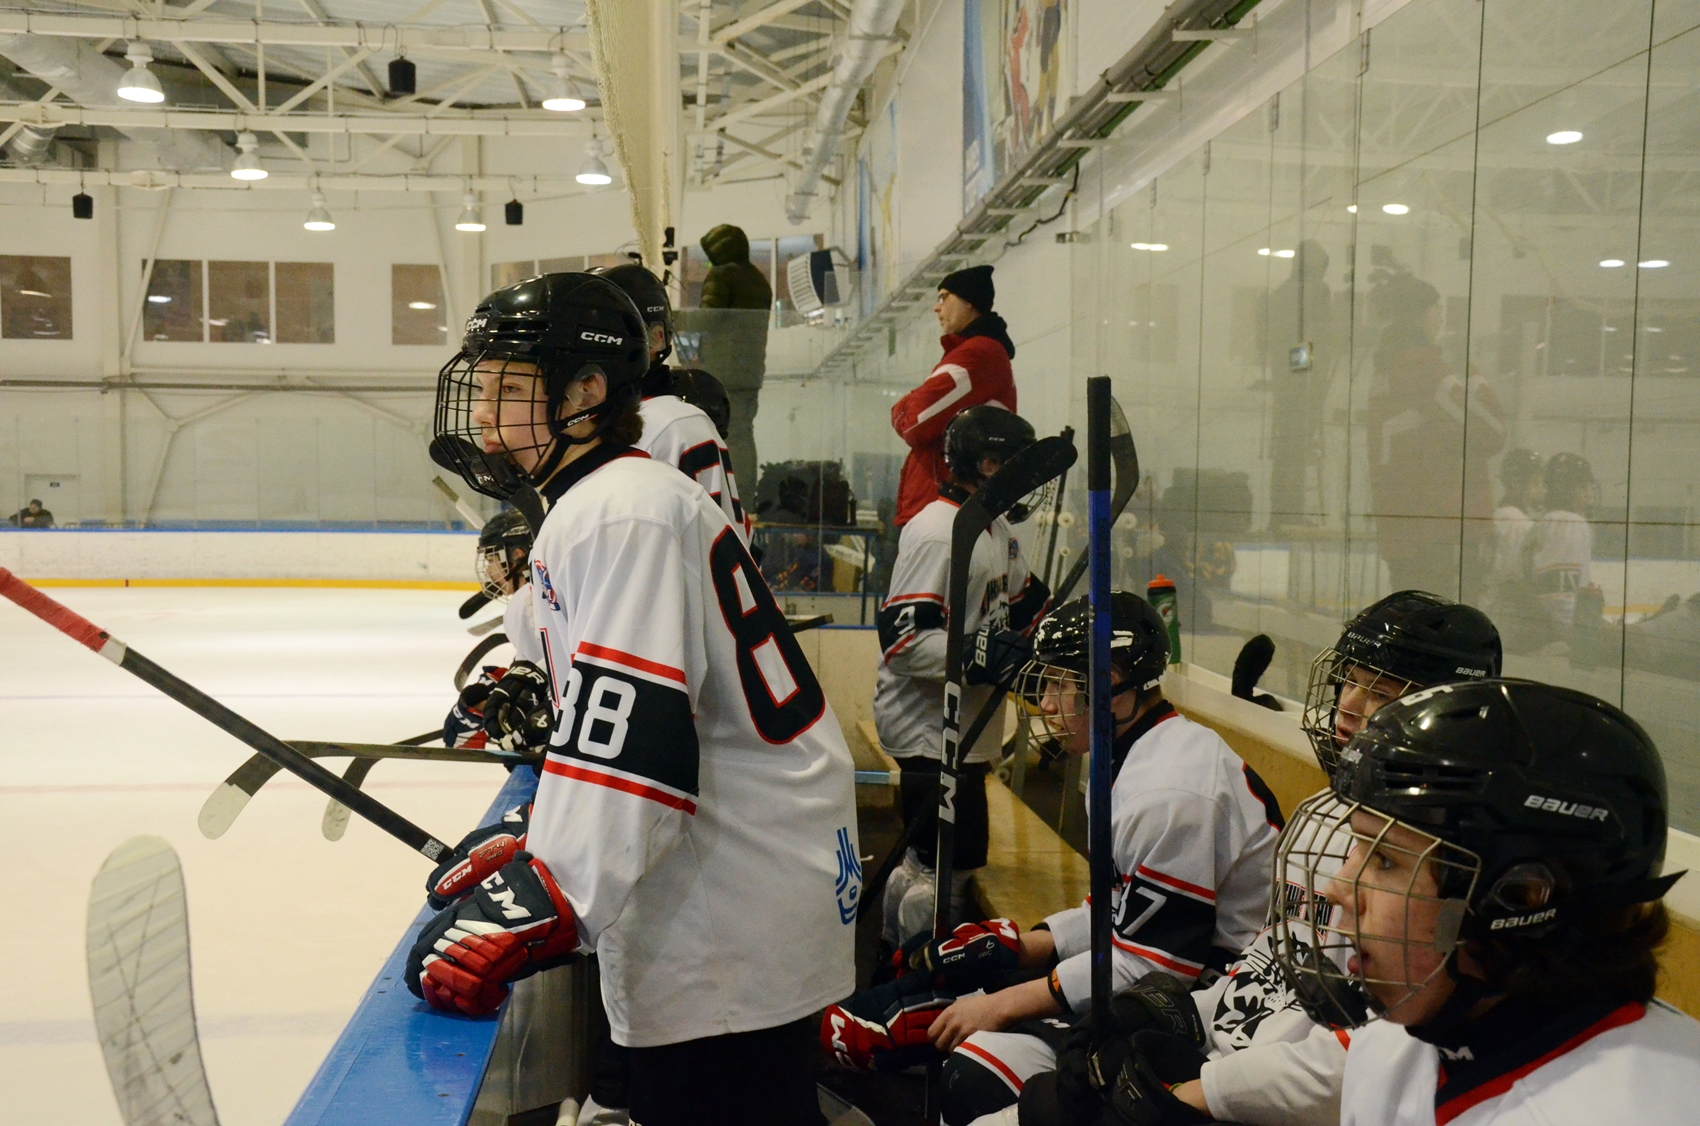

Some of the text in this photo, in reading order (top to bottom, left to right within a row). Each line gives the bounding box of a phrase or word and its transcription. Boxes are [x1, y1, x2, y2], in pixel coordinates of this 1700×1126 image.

[580, 331, 623, 346] CCM
[566, 413, 590, 427] CCM
[1455, 666, 1487, 678] BAUER
[938, 680, 961, 824] CCM
[1523, 794, 1609, 822] BAUER
[442, 864, 473, 890] CCM
[1490, 908, 1557, 930] BAUER
[943, 953, 966, 964] CCM
